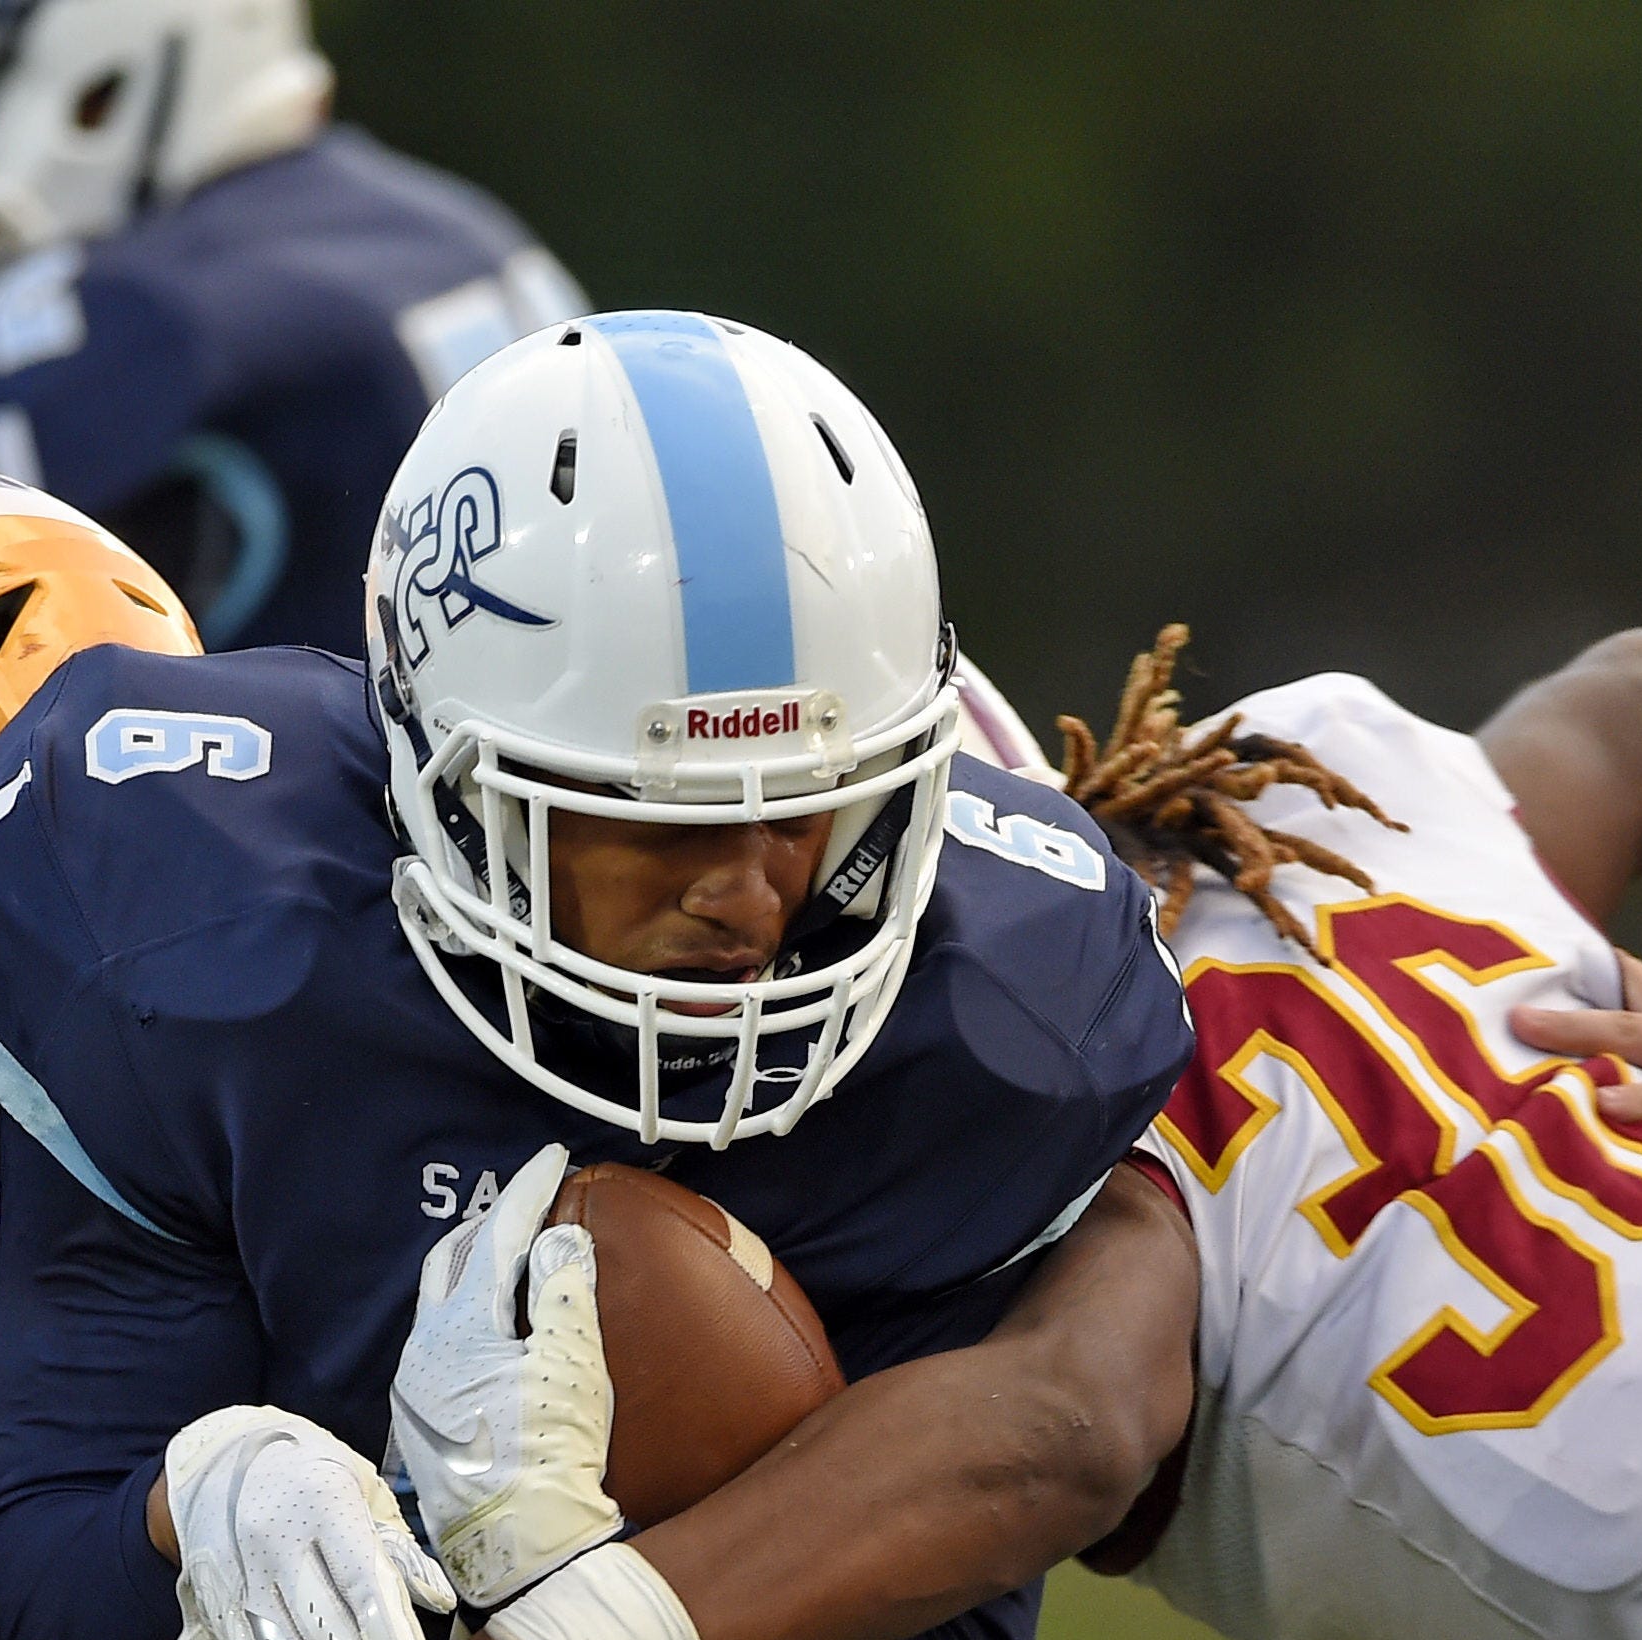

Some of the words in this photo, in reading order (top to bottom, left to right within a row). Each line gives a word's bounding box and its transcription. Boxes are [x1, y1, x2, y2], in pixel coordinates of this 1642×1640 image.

[85, 707, 273, 785] 6
[687, 701, 799, 739] Riddell
[942, 789, 1107, 893] 6
